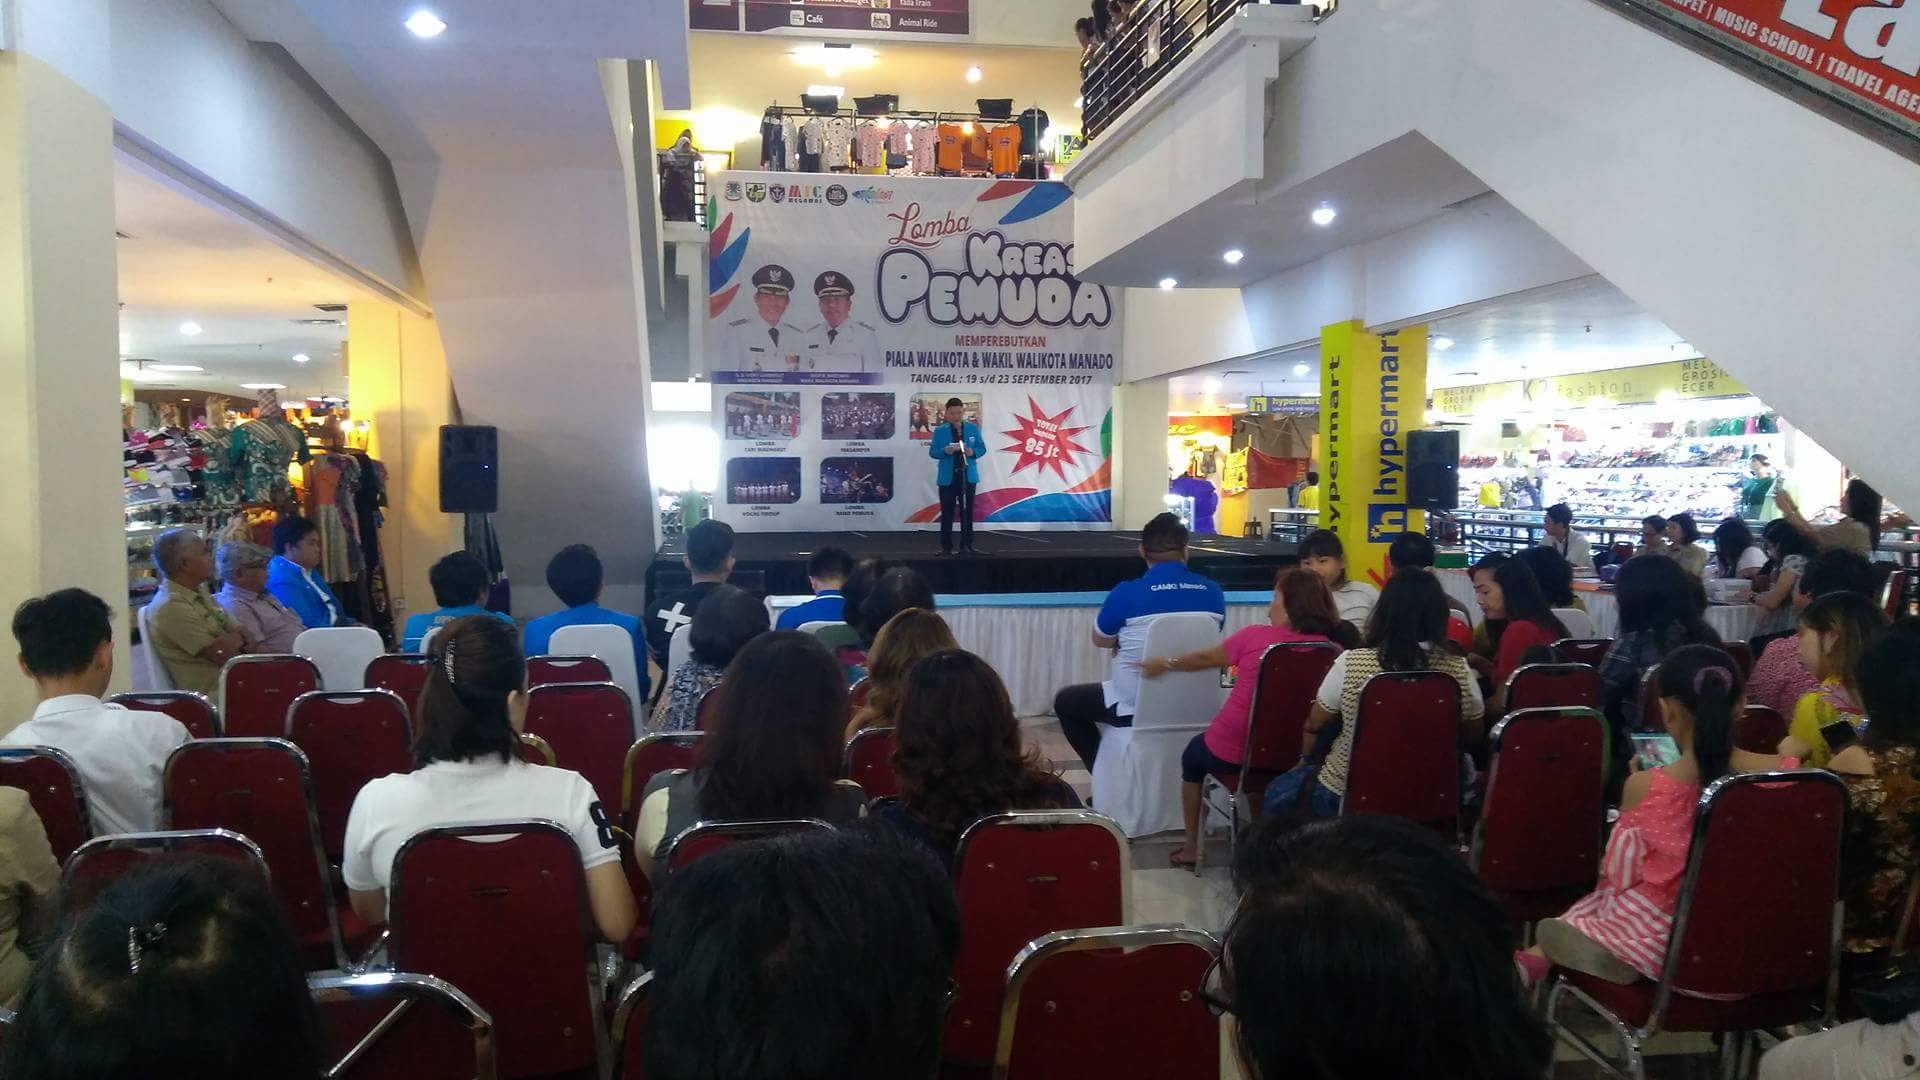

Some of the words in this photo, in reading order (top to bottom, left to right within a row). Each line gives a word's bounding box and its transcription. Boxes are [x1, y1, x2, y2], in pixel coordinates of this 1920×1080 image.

[806, 14, 823, 23] Café
[899, 18, 922, 27] Animal
[923, 19, 938, 28] Ride
[1714, 6, 1758, 37] MUSIC
[1759, 27, 1815, 64] SCHOOL
[1826, 56, 1884, 96] TRAVEL
[887, 202, 972, 248] Lomba
[878, 248, 1111, 326] PEMUDA
[955, 335, 1046, 348] MEMPEREBUTKAN
[886, 351, 914, 367] PIALA
[917, 351, 969, 368] WALIKOTA
[972, 352, 980, 368] &
[981, 352, 1013, 369] WAKIL
[1016, 352, 1067, 369] WALIKOTA
[1069, 353, 1113, 370] MANADO
[911, 373, 957, 383] TANGGAL
[966, 374, 977, 384] 19
[979, 374, 996, 384] s/d
[998, 374, 1009, 384] 23
[1011, 374, 1067, 385] SEPTEMBER
[1069, 375, 1092, 385] 2017
[1682, 381, 1714, 392] ECER
[1272, 398, 1320, 408] hypermart
[1025, 437, 1045, 456] 85
[1328, 355, 1341, 533] ypermart
